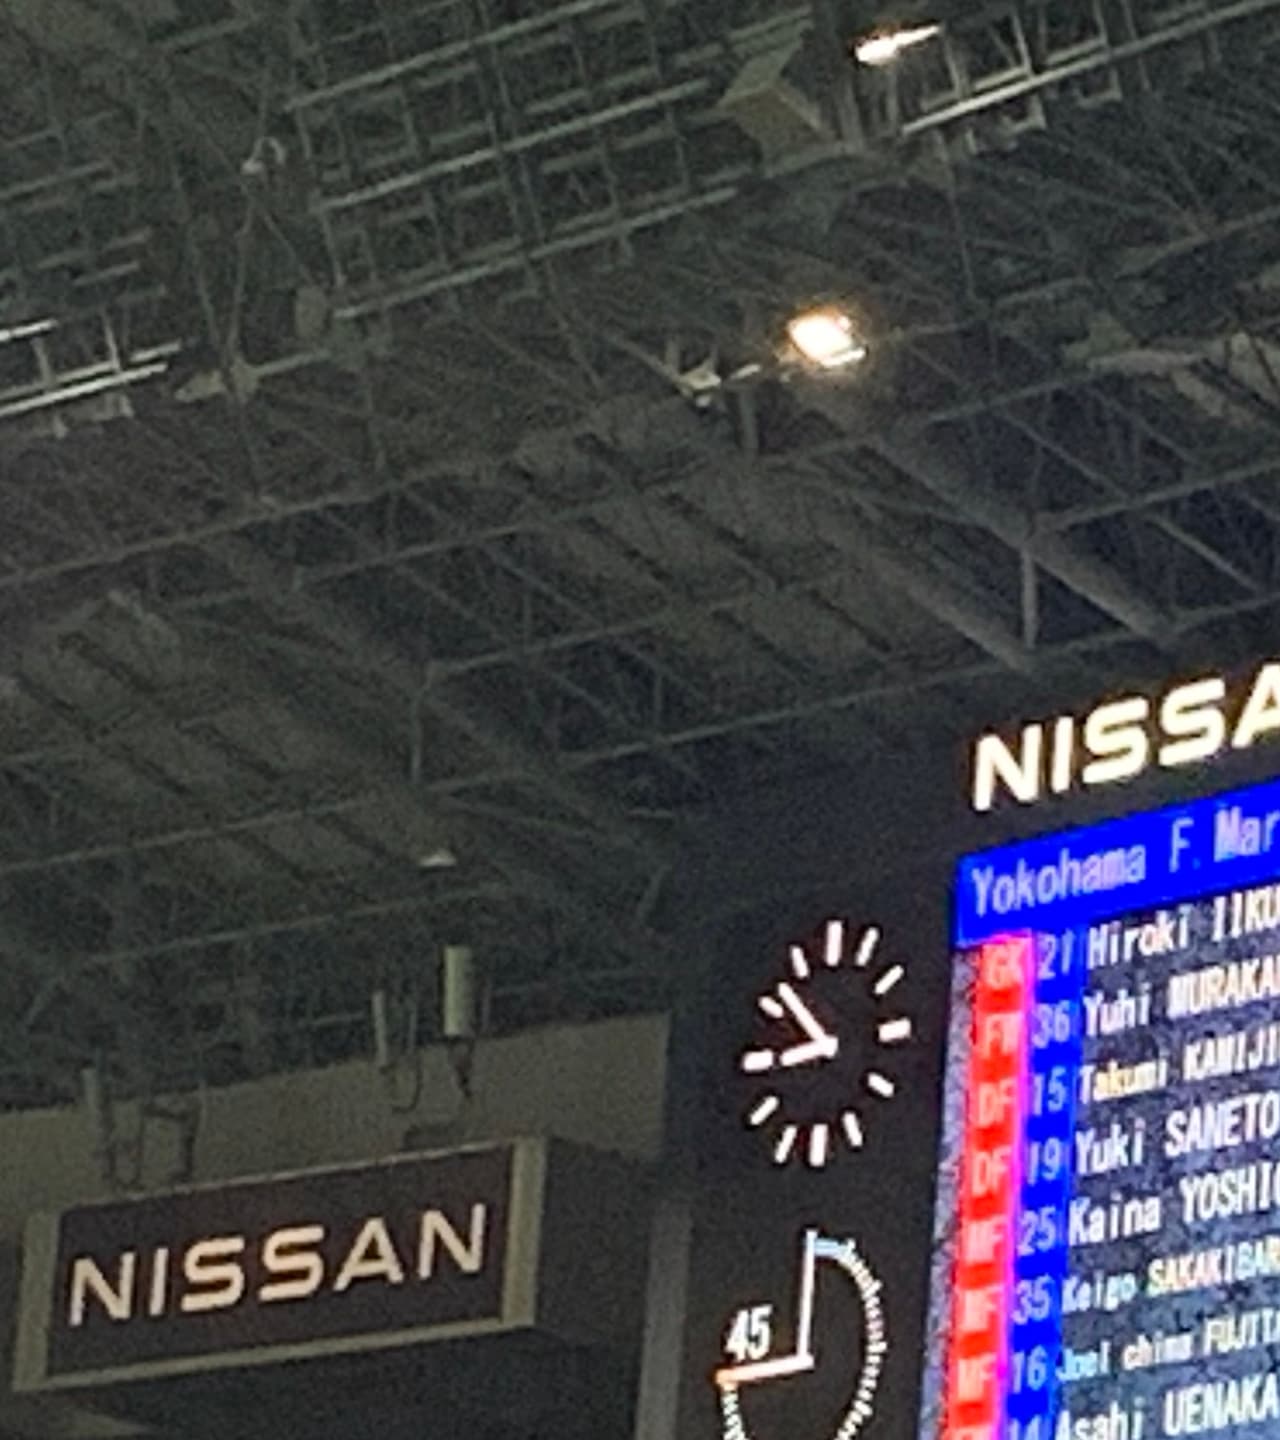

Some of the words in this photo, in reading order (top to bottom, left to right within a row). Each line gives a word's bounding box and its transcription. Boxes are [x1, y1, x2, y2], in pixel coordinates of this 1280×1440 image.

[970, 843, 1147, 917] Yokohama
[1037, 929, 1075, 980] 21
[1086, 910, 1191, 971] Hiroki
[1084, 984, 1152, 1038] Yuhi
[1033, 1067, 1068, 1115] 15
[1028, 1140, 1062, 1187] 19
[1075, 1121, 1145, 1175] Yuki
[1020, 1205, 1057, 1250] 25
[1068, 1193, 1161, 1247] Kaina
[68, 1203, 487, 1327] NISSAN
[1011, 1275, 1051, 1326] 35
[726, 1306, 772, 1362] 45
[1011, 1349, 1048, 1393] 16
[1164, 1373, 1280, 1435] UENAKA
